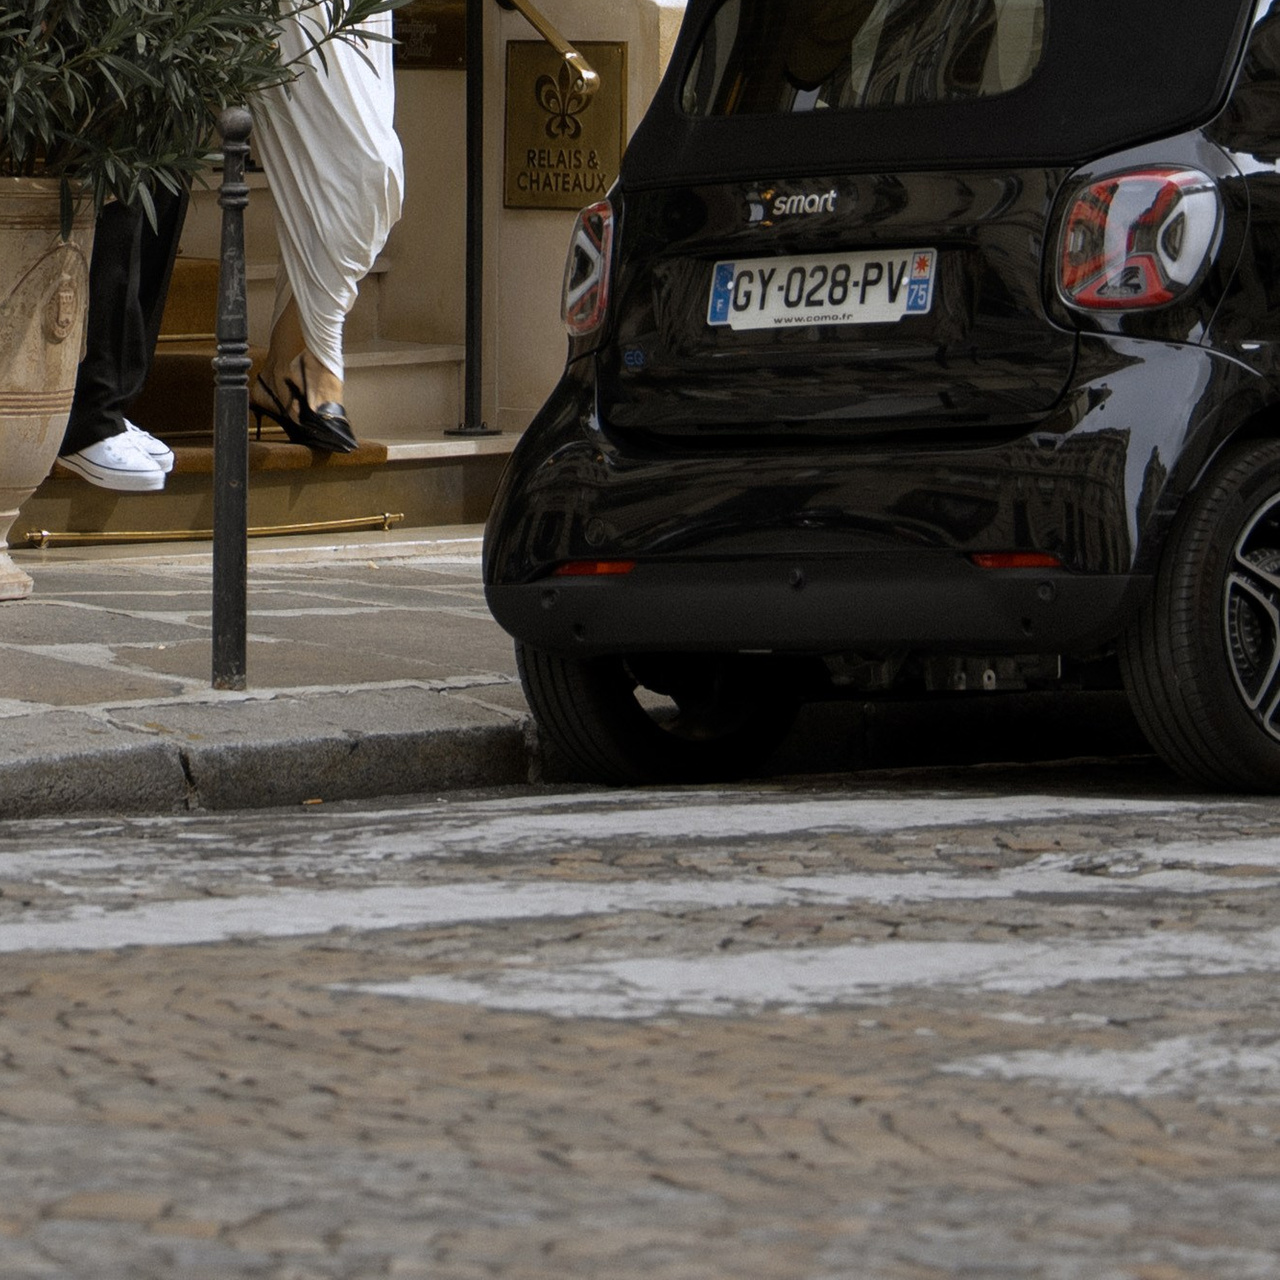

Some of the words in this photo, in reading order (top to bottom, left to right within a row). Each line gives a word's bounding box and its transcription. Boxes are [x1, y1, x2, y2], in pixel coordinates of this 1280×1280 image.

[526, 149, 582, 170] RELAIS
[587, 150, 601, 169] &
[517, 172, 608, 193] CHATEAUX
[772, 190, 837, 215] smart
[732, 260, 908, 312] GY-028-PV
[908, 284, 928, 306] 75
[716, 299, 724, 312] F
